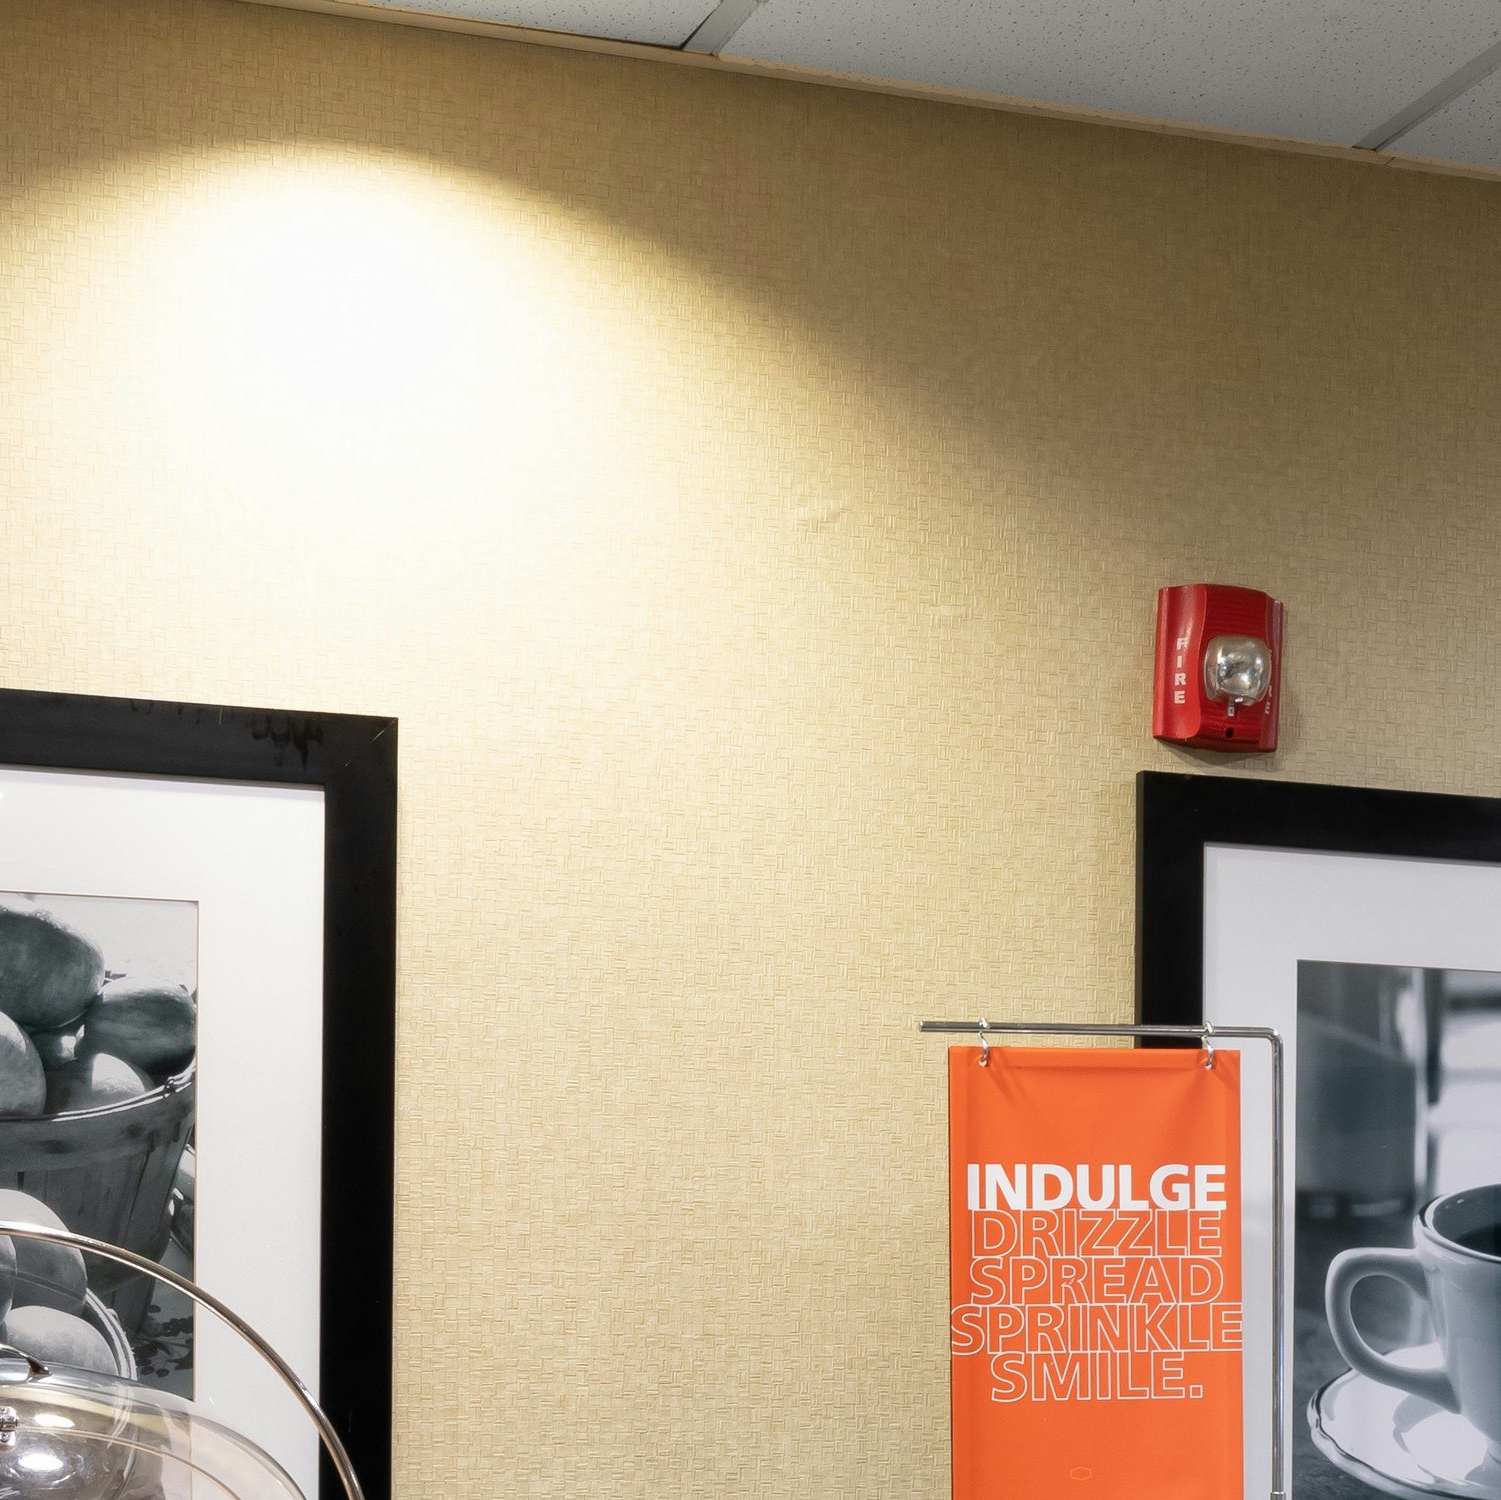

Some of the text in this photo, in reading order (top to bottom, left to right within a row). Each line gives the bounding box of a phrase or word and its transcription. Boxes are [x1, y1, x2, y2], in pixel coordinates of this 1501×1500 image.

[1174, 637, 1190, 704] FIRE
[966, 1163, 1227, 1211] INDULGE
[971, 1208, 1223, 1258] DRIZZLE
[969, 1256, 1224, 1306] SPREAD
[951, 1302, 1243, 1356] SPRINKLE
[990, 1350, 1204, 1402] SMILE.
